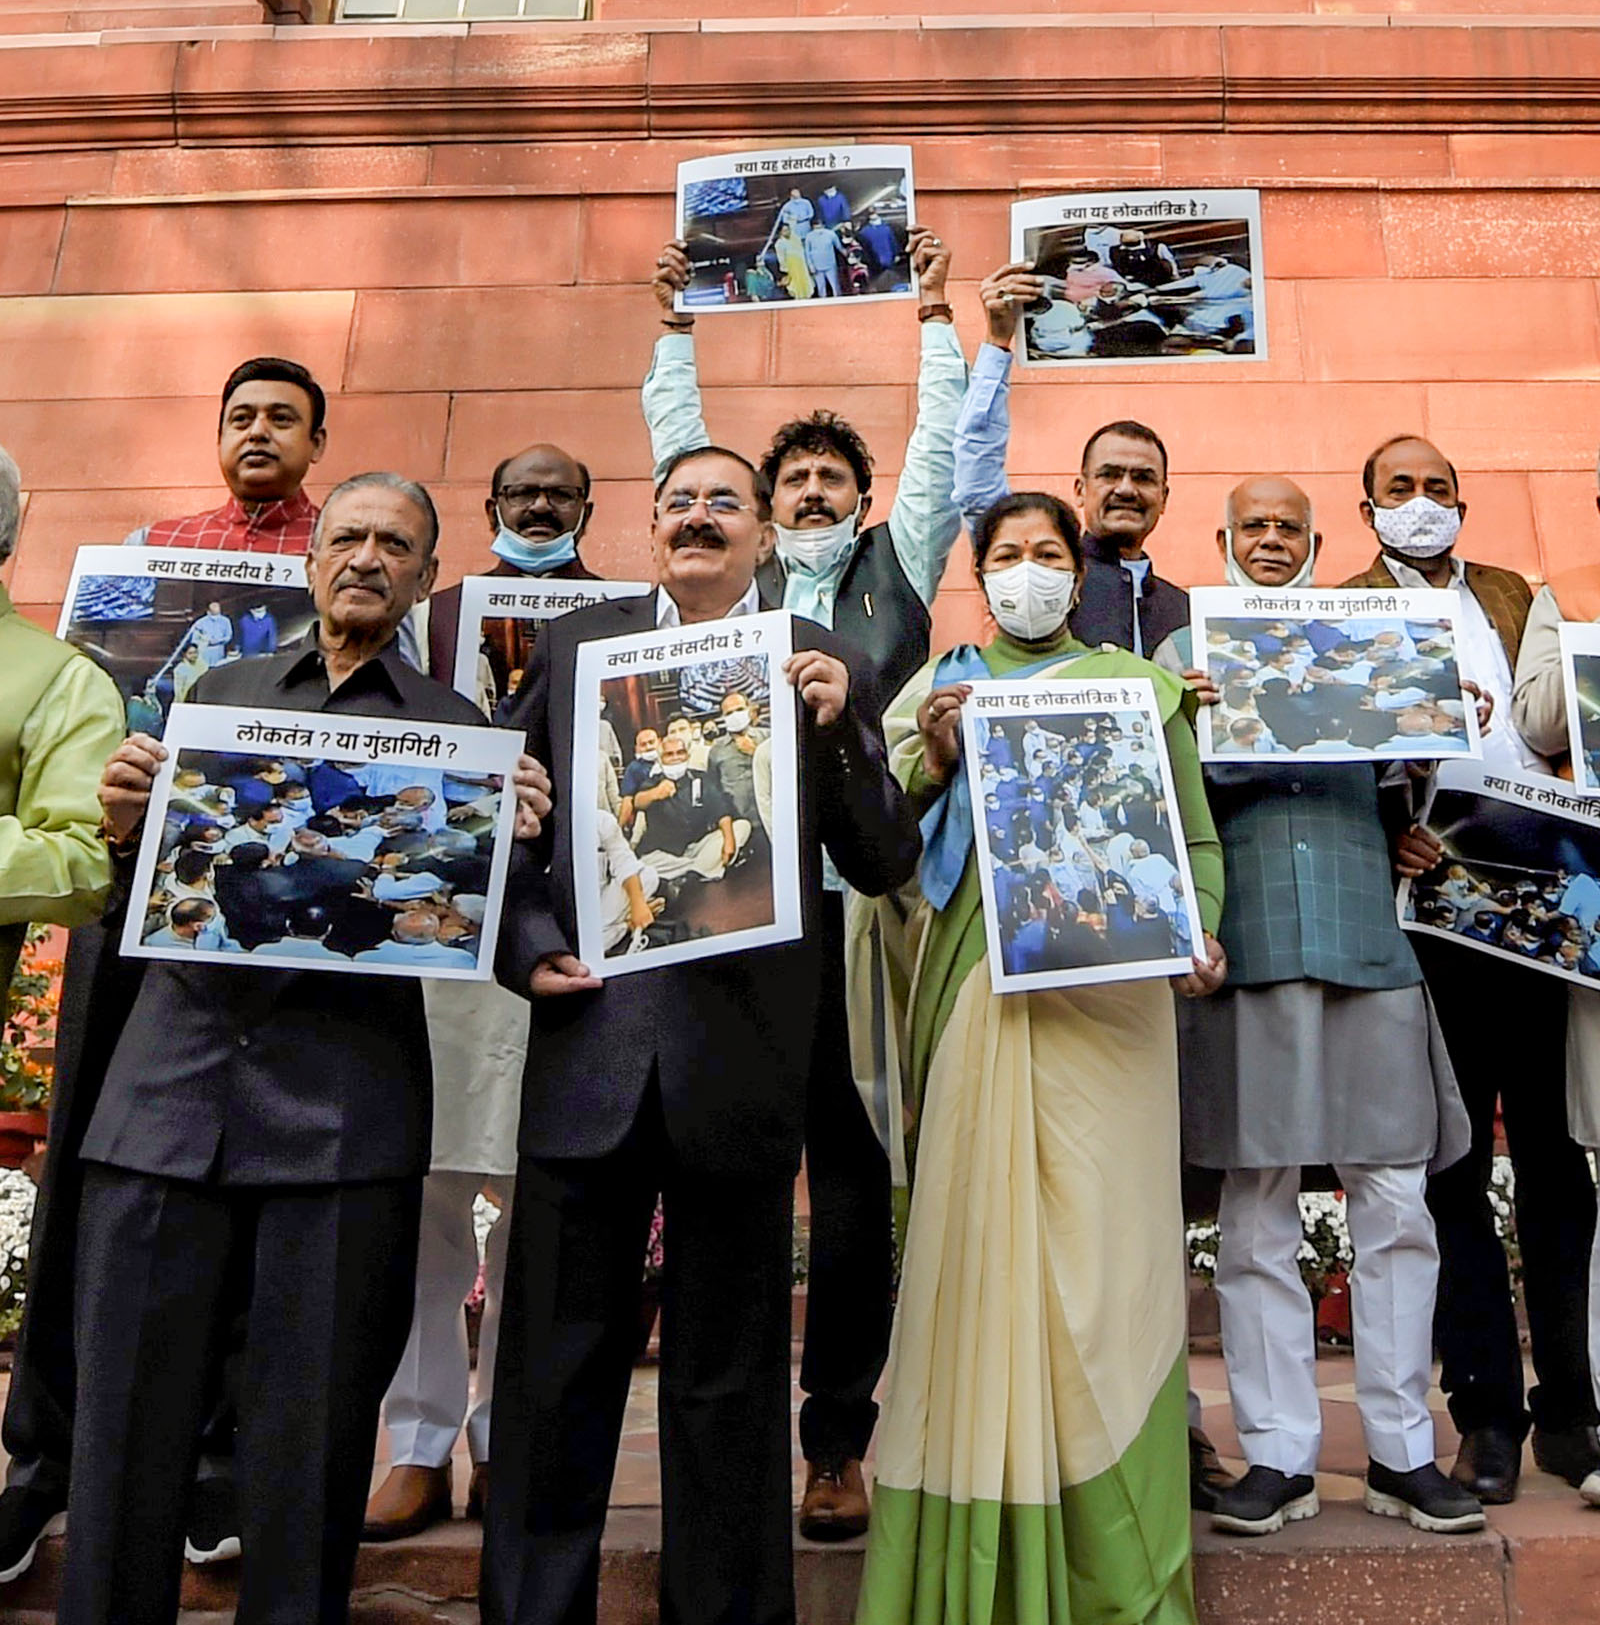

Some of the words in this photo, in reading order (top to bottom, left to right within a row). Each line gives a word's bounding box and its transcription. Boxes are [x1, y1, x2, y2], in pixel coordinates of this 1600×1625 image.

[734, 161, 758, 174] क्या
[760, 159, 779, 172] यह
[781, 155, 826, 170] संसदीय
[828, 153, 837, 169] है
[1062, 208, 1087, 219] क्या
[1090, 206, 1109, 220] यह
[1112, 200, 1187, 218] लोकतांत्रिक
[1189, 198, 1198, 217] है
[147, 559, 177, 574] क्या
[180, 561, 202, 577] यह
[205, 559, 262, 580] संसदीय
[264, 562, 276, 583] है
[488, 592, 517, 607] क्या
[520, 594, 541, 610] यह
[1242, 594, 1301, 611] लोकतंत्र
[1317, 600, 1335, 613] या
[1337, 595, 1398, 617] गुंडागिरी
[607, 649, 639, 667] क्या
[642, 645, 667, 662] यह
[670, 634, 731, 657] संसदीय
[733, 628, 744, 648] है
[975, 694, 1005, 709] क्या
[1008, 693, 1031, 709] यह
[1034, 689, 1118, 707] लोकतांत्रिक
[1121, 688, 1131, 706] है
[236, 720, 315, 747] लोकतंत्र
[337, 732, 360, 751] या
[363, 730, 442, 760] गुंडागिरी
[1483, 775, 1511, 794] क्या
[1514, 781, 1536, 801] यह
